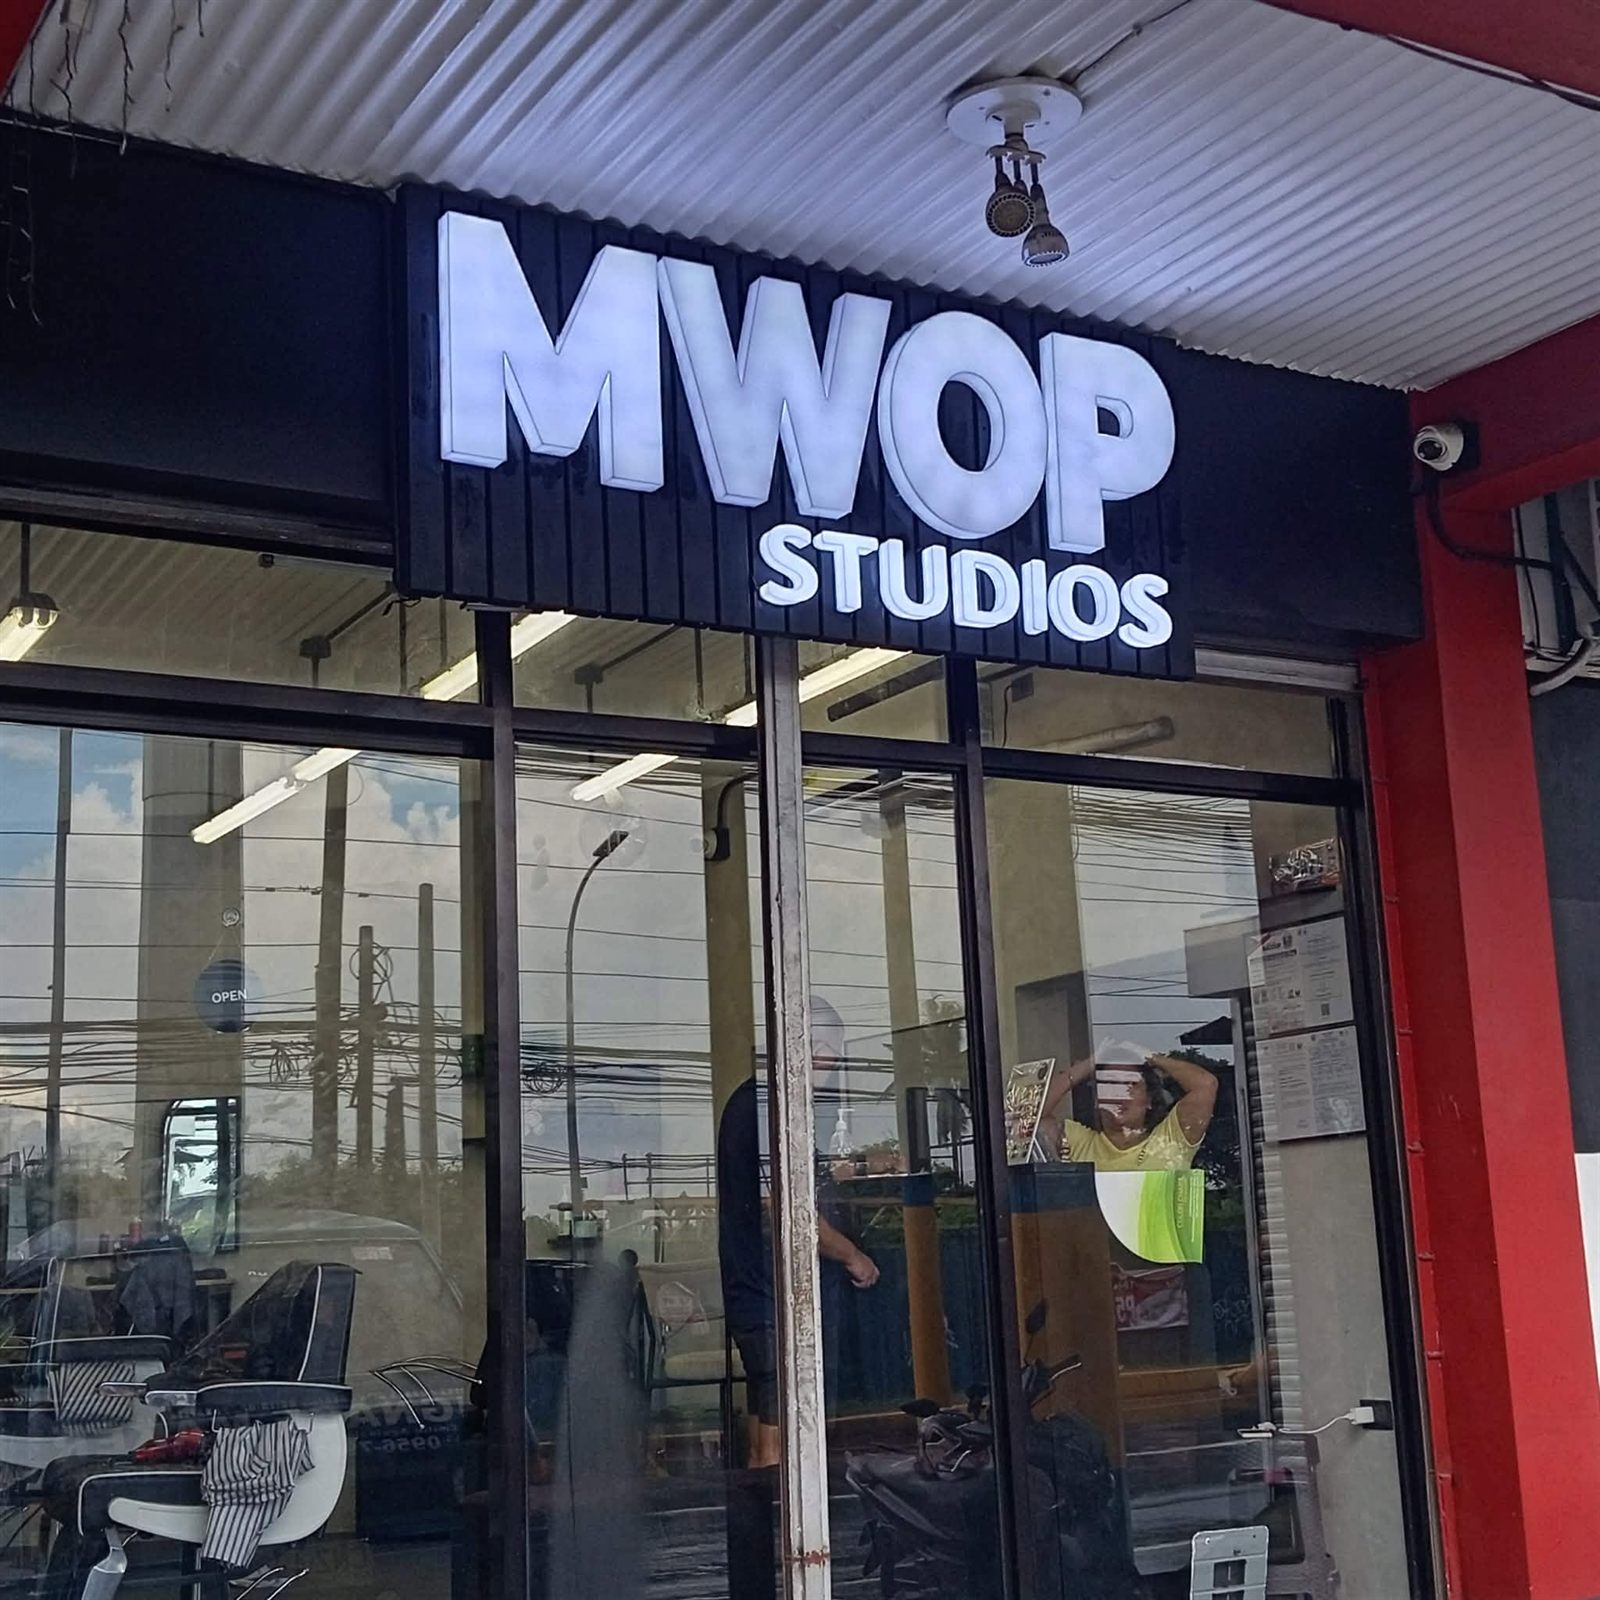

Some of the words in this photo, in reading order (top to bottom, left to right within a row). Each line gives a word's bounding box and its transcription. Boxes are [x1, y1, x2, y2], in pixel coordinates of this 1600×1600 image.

[438, 210, 1176, 555] MWOP
[758, 523, 1173, 649] STUDIOS
[211, 988, 248, 1004] OPEN
